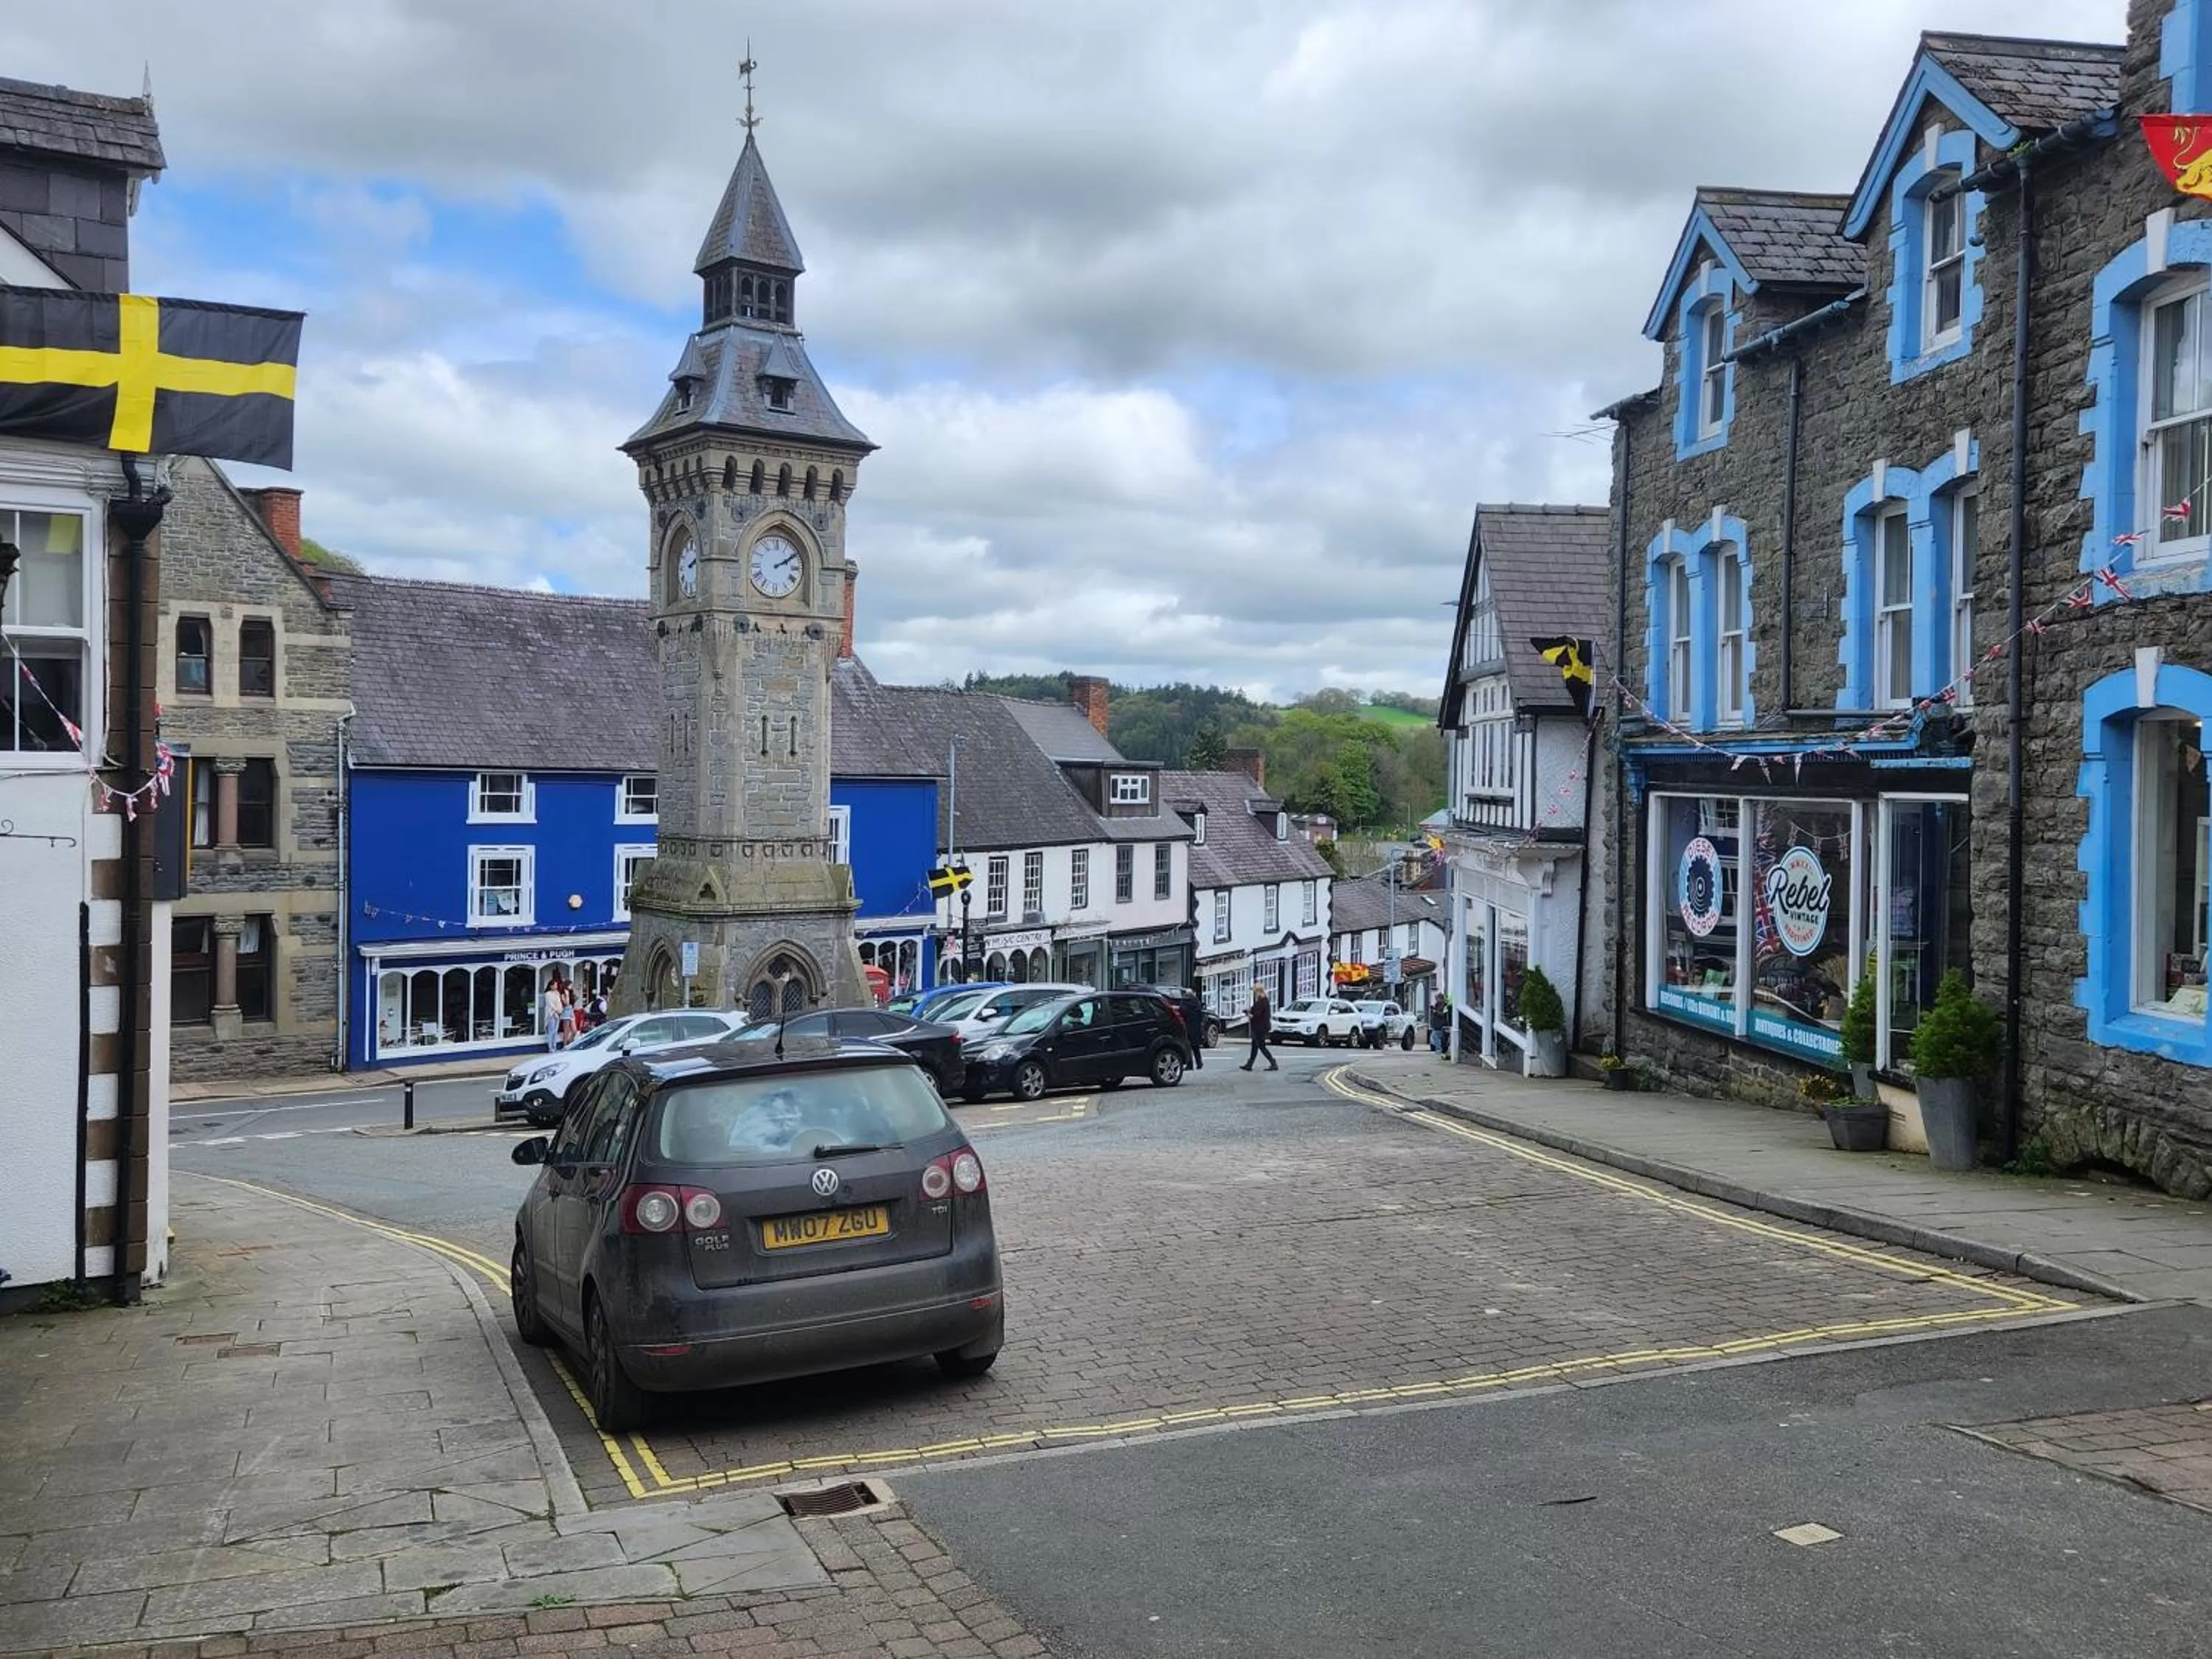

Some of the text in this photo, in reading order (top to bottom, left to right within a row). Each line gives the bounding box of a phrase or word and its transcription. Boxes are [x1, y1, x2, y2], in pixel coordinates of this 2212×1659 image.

[1768, 866, 1831, 914] Rebel
[1682, 903, 1719, 934] RECORDS
[1790, 911, 1819, 925] VINTAGE
[504, 949, 574, 961] PRINCE & PUGH
[1754, 1017, 1787, 1040] ANTIQUES
[1787, 1028, 1792, 1042] &
[931, 1205, 947, 1214] TDI
[773, 1207, 879, 1243] MW07 ZGU
[695, 1234, 729, 1245] GOLF
[704, 1242, 729, 1251] PLUS
